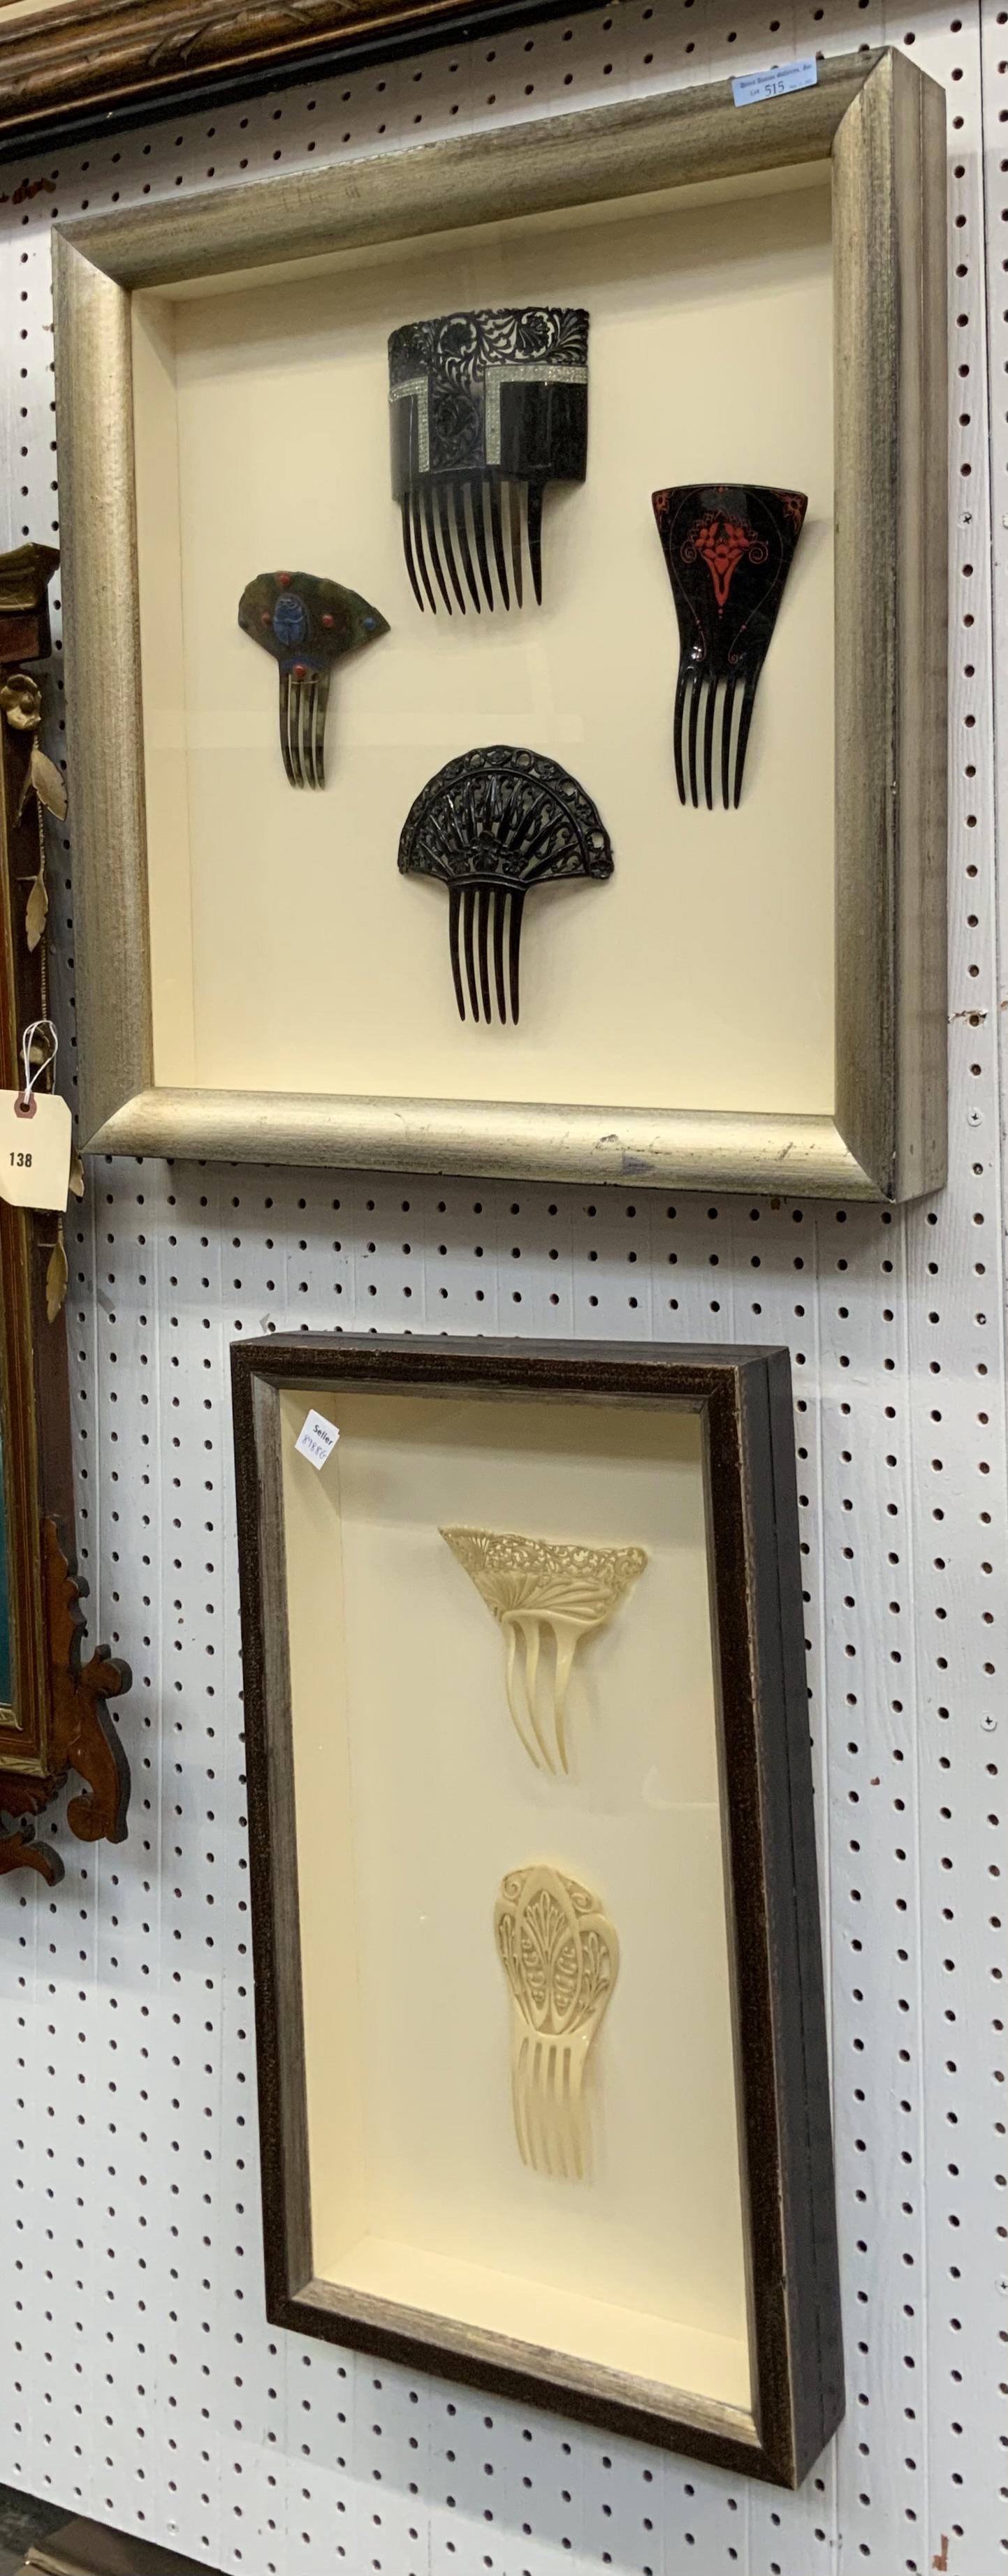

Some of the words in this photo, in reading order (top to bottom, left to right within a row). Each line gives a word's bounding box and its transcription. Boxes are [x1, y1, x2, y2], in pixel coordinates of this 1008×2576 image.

[765, 80, 784, 97] 515
[9, 1151, 33, 1168] 138
[312, 1424, 334, 1445] Seller
